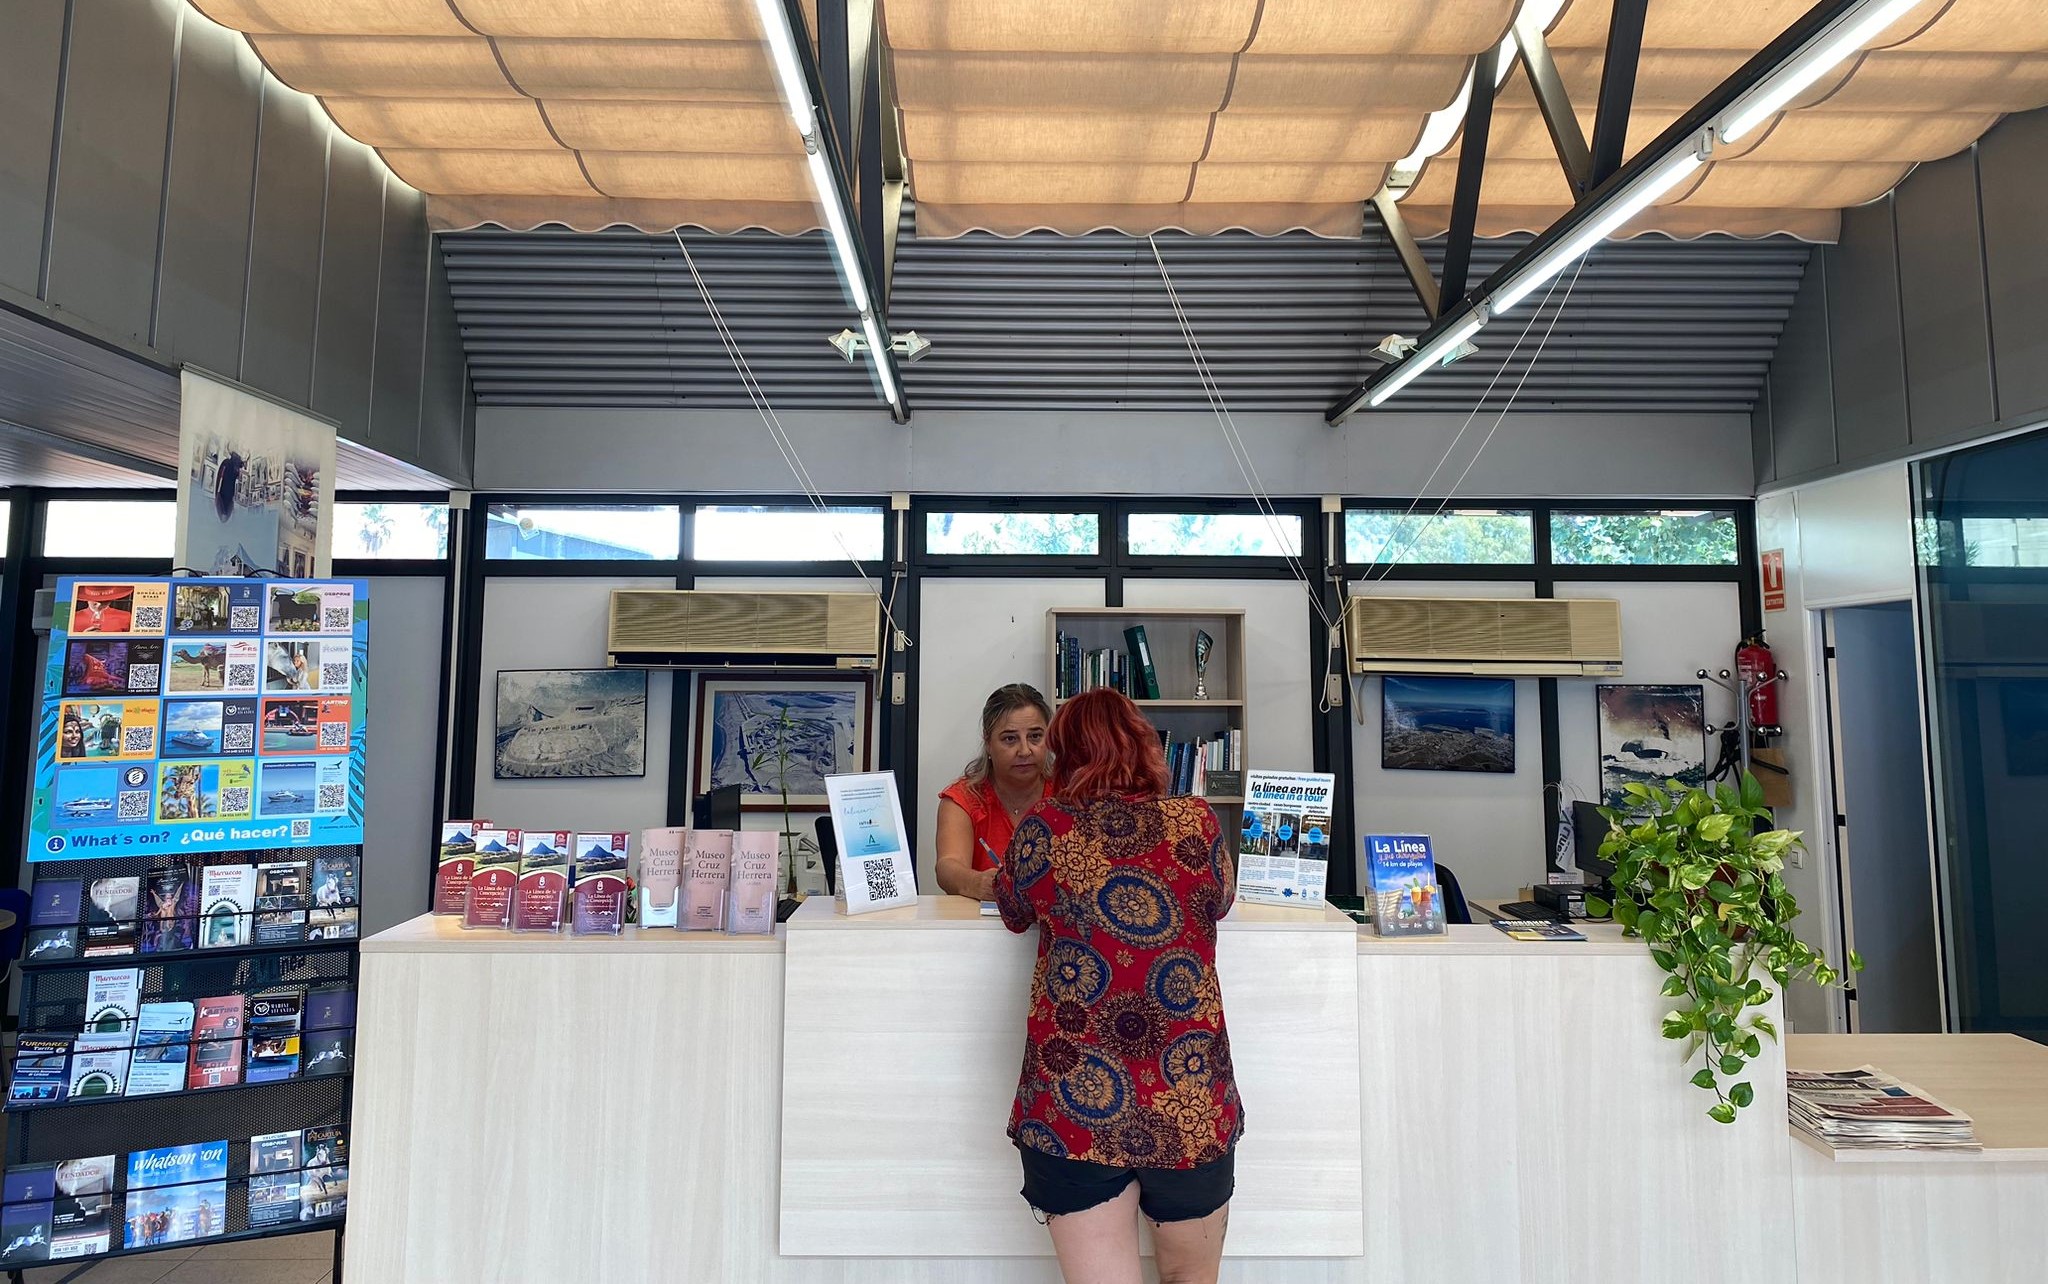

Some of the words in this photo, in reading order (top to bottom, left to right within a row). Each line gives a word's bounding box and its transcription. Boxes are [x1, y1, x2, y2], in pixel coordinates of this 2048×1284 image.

[1251, 782, 1262, 792] la
[1263, 783, 1290, 795] línea
[1291, 787, 1304, 796] en
[1305, 788, 1328, 798] ruta
[1305, 795, 1325, 803] tour
[139, 832, 170, 844] on?
[181, 829, 225, 844] ¿Qué
[230, 826, 288, 840] hacer?
[1375, 840, 1391, 853] La
[1394, 840, 1427, 853] Línea
[650, 849, 679, 857] Museo
[696, 850, 725, 859] Museo
[741, 851, 771, 859] Museo
[653, 858, 675, 866] Cruz
[698, 860, 721, 869] Cruz
[744, 861, 766, 869] Cruz
[647, 868, 681, 876] Herrera
[691, 869, 725, 879] Herrera
[737, 871, 772, 879] Herrera
[134, 1152, 197, 1171] whatson
